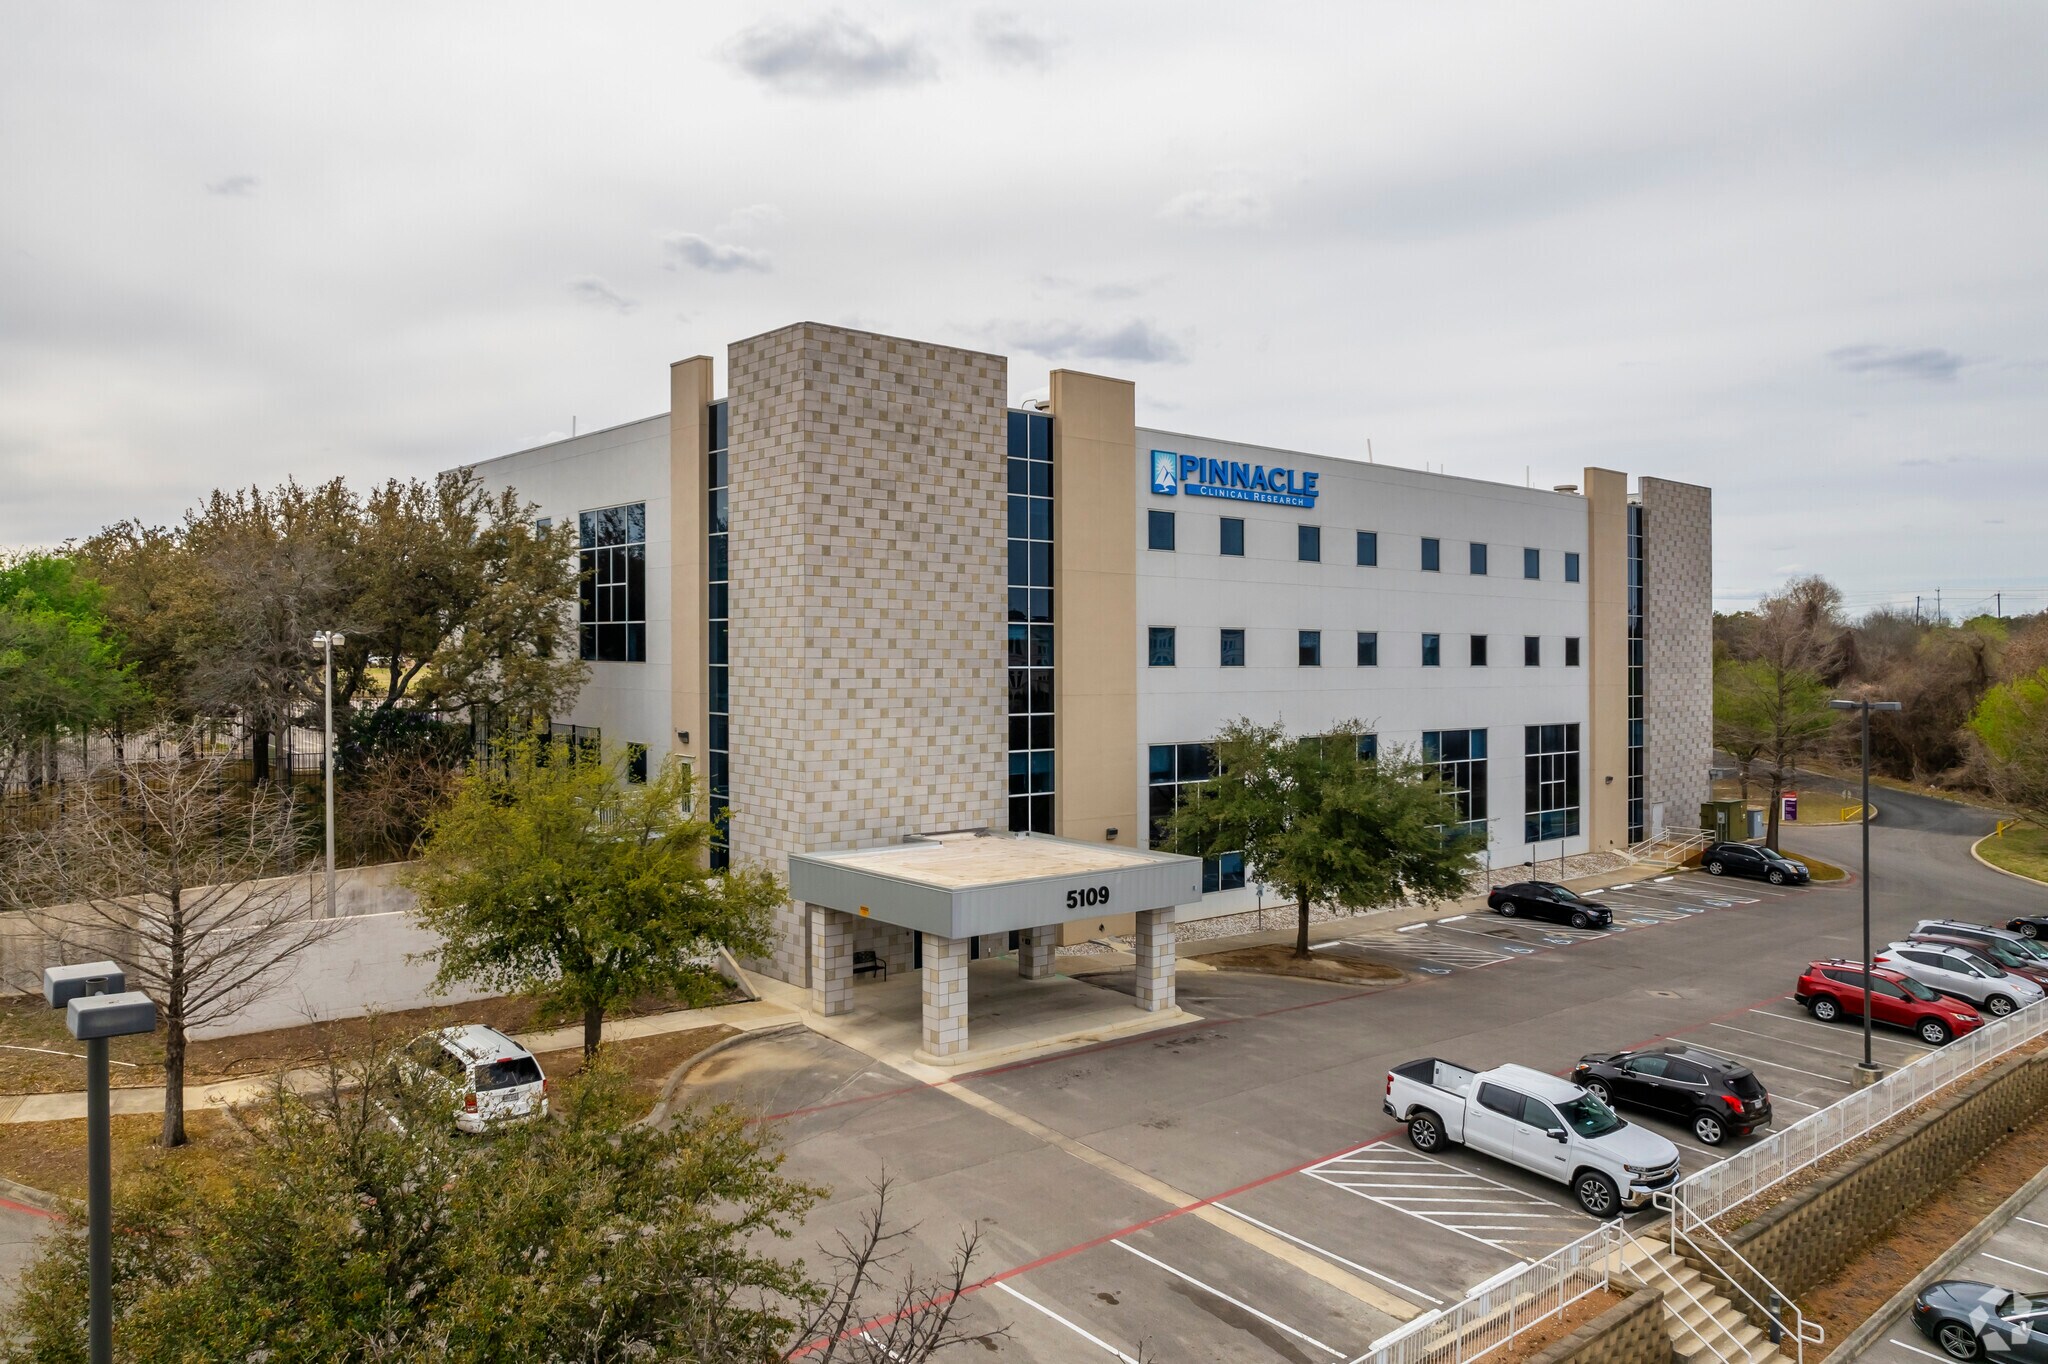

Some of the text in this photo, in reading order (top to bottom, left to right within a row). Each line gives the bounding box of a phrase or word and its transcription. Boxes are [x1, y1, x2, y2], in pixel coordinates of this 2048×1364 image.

[1179, 454, 1319, 497] PINNACLE
[1200, 486, 1304, 506] CLINICAL RESEARCH
[1066, 886, 1110, 909] 5109
